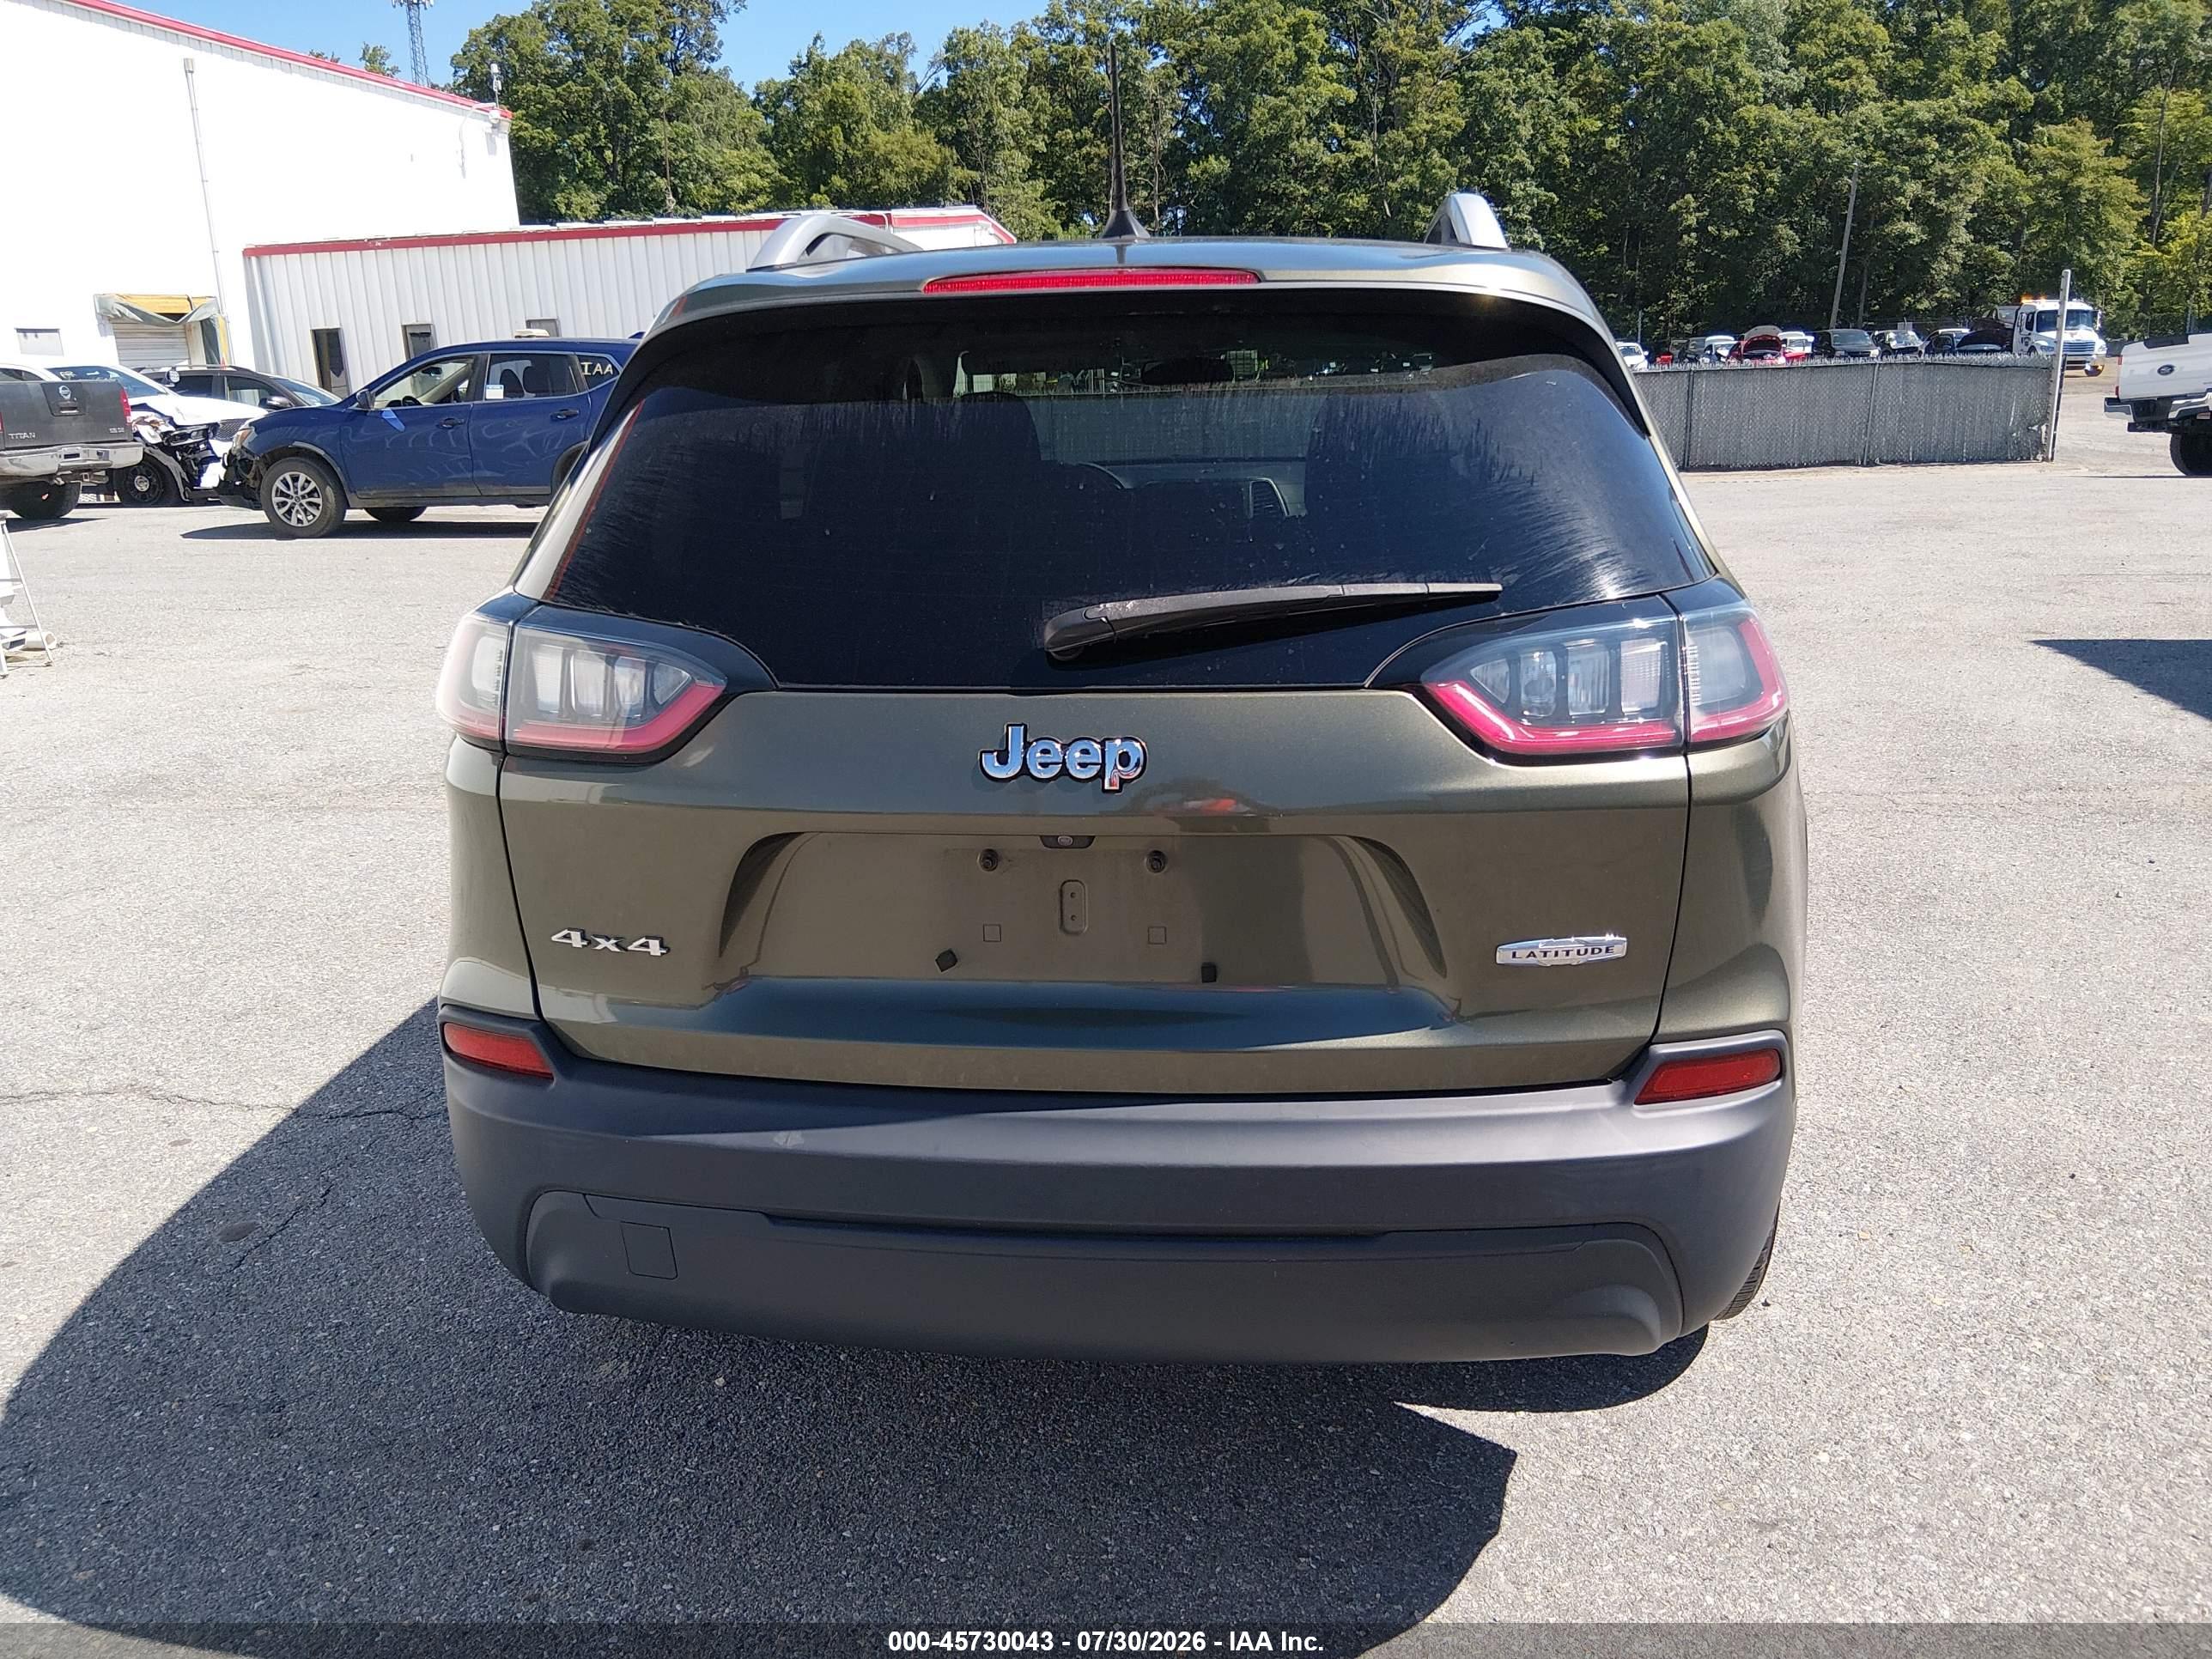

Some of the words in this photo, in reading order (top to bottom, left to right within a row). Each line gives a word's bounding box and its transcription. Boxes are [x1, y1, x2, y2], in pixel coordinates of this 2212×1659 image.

[580, 362, 613, 376] IAA
[979, 723, 1147, 793] Jeep
[551, 927, 670, 956] 4x4
[1511, 945, 1615, 959] LATITUDE
